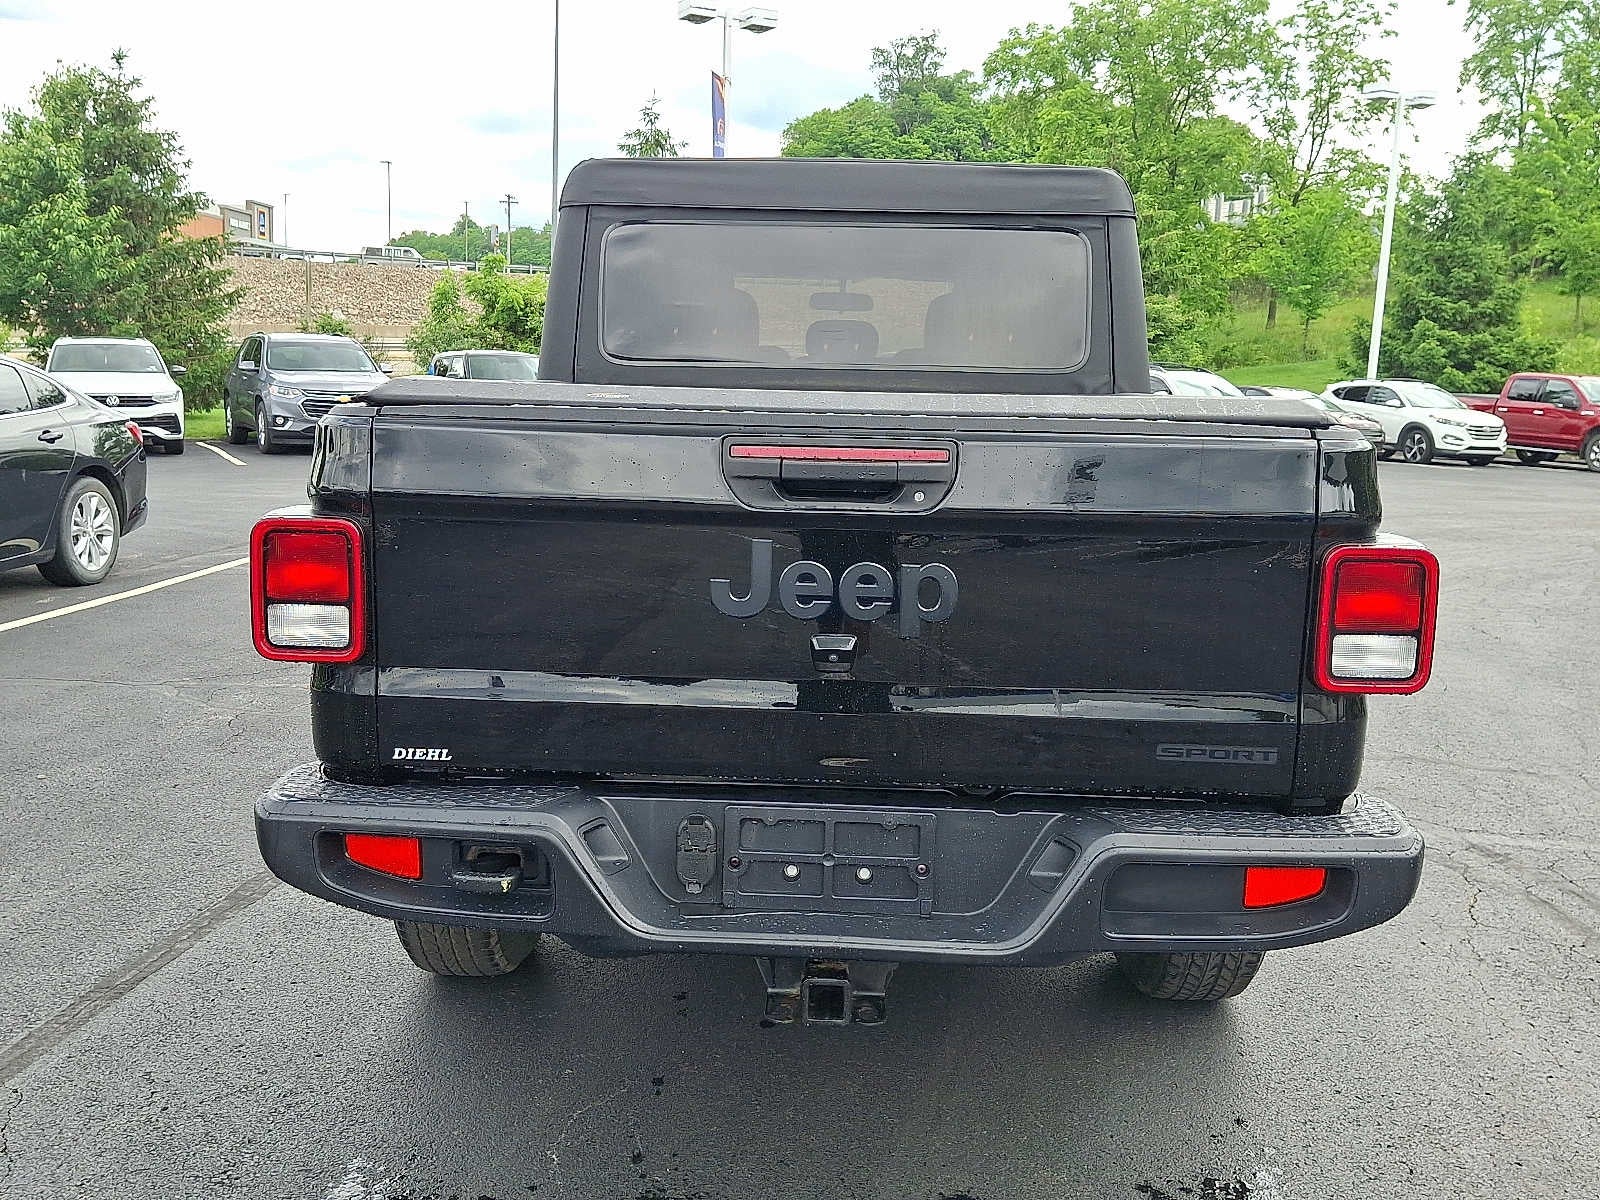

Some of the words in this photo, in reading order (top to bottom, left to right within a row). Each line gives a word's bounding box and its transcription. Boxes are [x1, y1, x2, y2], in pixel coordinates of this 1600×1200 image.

[709, 538, 960, 639] Jeep
[392, 747, 453, 761] DIEHL
[1157, 745, 1278, 763] SPORT
